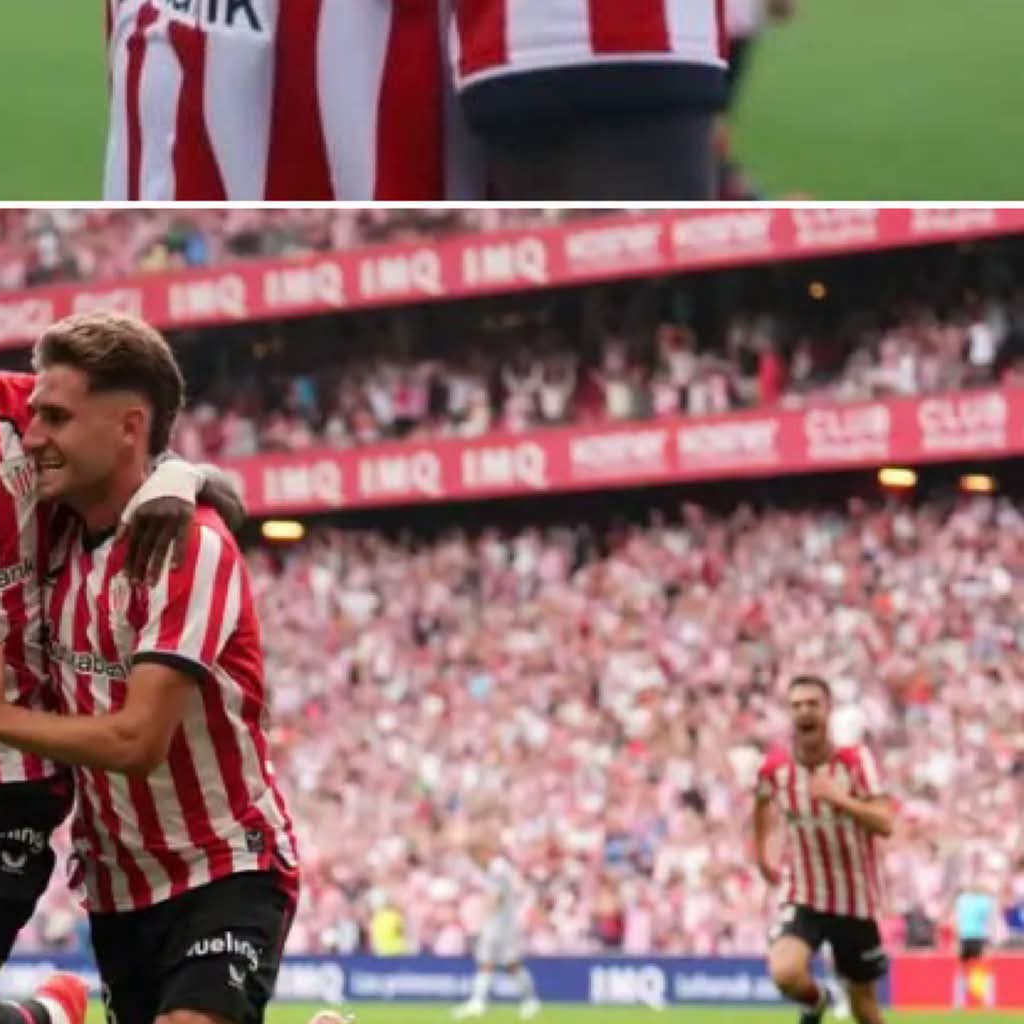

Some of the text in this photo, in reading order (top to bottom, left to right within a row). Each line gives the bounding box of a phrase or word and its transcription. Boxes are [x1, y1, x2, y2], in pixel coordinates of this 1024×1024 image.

[360, 250, 444, 294] IMQ
[462, 238, 550, 283] IMQ
[358, 451, 442, 496] IMQ
[462, 442, 548, 488] IMQ
